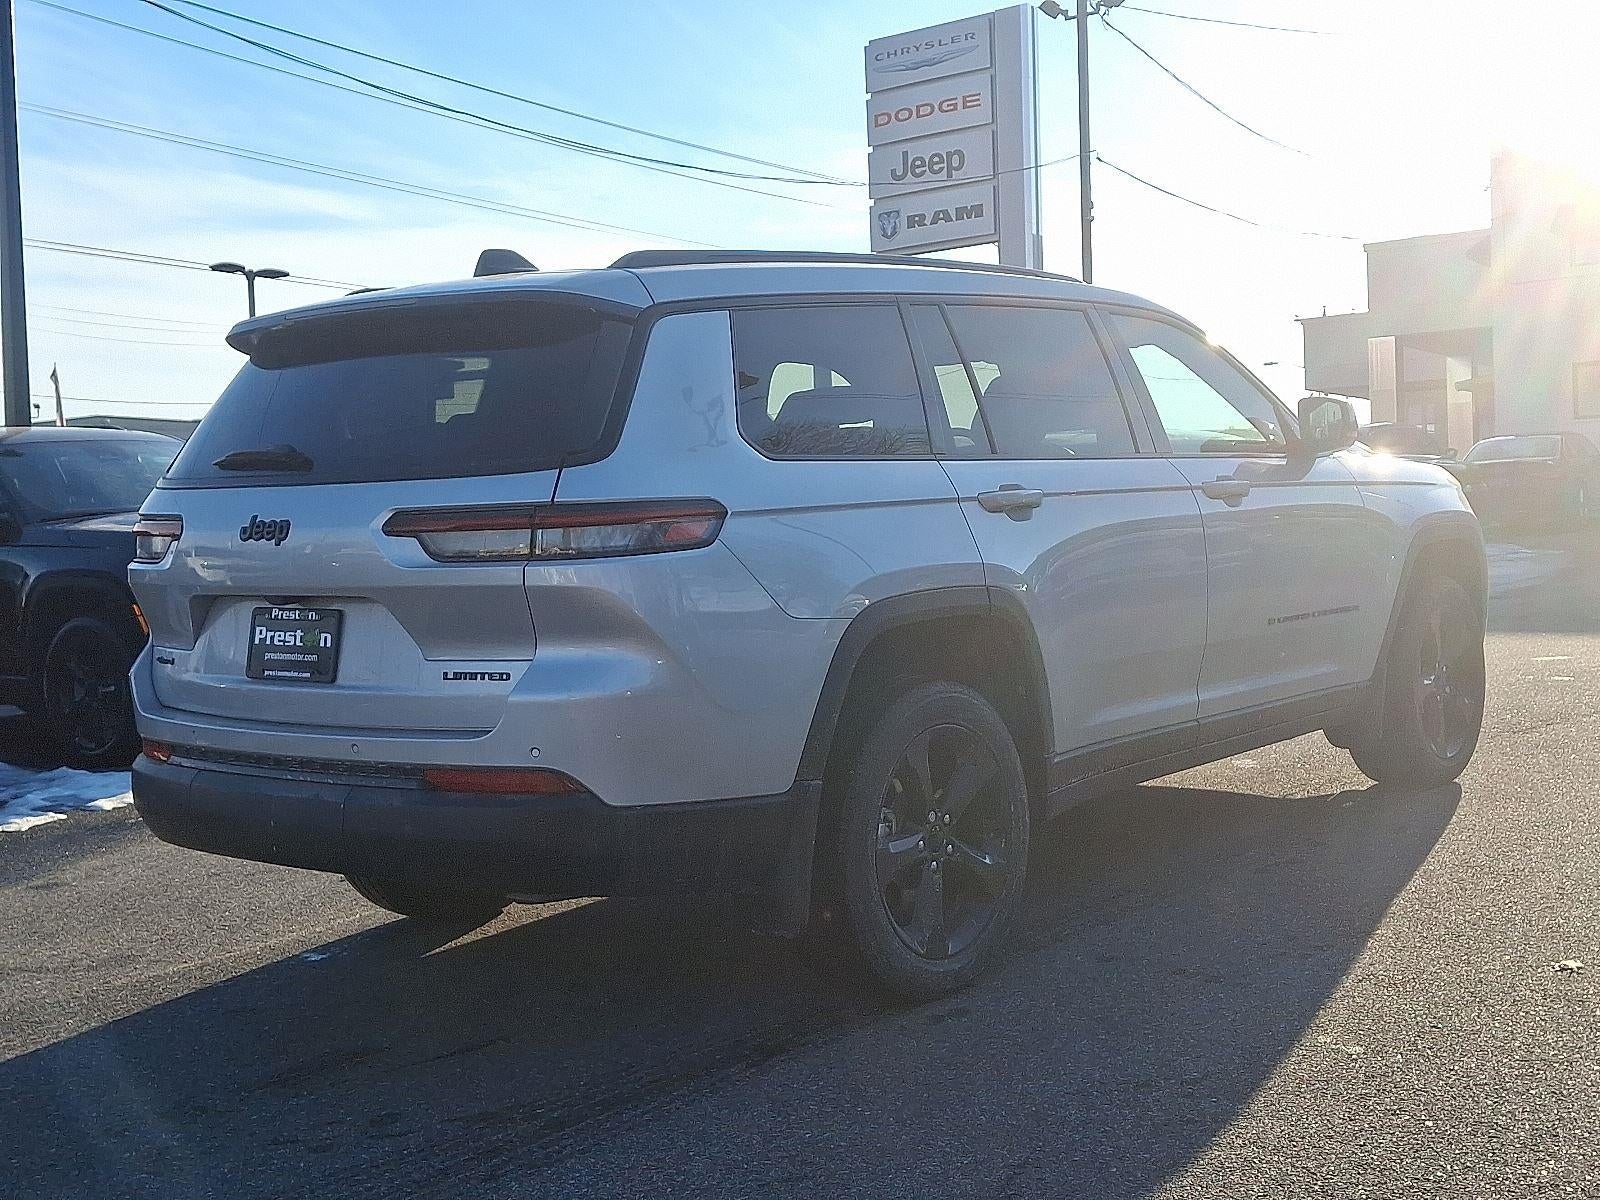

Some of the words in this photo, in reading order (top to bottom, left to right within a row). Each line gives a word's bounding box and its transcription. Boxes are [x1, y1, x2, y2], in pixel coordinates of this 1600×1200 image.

[874, 32, 977, 62] CHRYSLER
[874, 92, 982, 129] DODGE
[890, 148, 966, 182] Jeep
[906, 203, 984, 230] RAM
[239, 514, 292, 546] Jeep
[264, 652, 318, 662] prestonmotor.com
[442, 671, 511, 681] LIMITED
